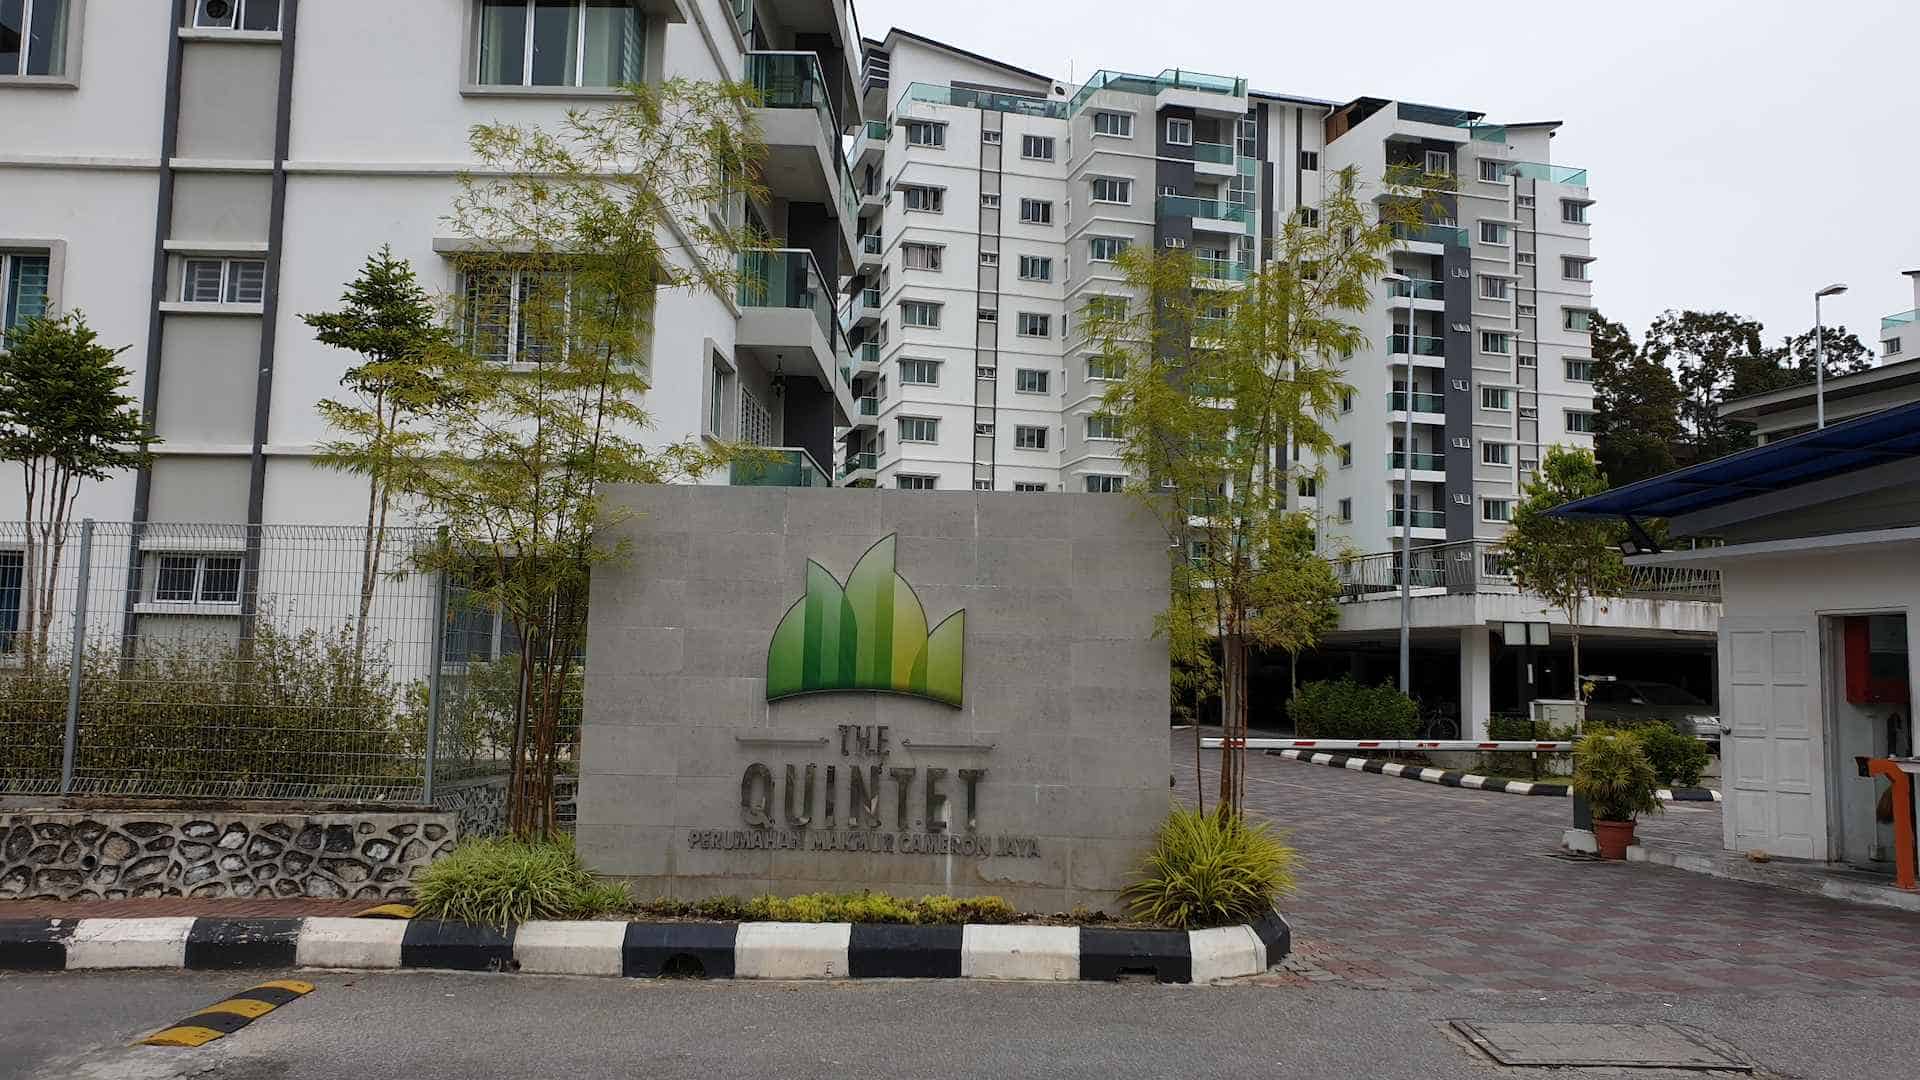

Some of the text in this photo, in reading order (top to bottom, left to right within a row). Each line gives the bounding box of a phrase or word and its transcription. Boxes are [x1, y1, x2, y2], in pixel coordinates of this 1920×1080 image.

[838, 724, 890, 757] THE
[741, 762, 988, 832] QUINTET
[688, 830, 1041, 858] PERUMAHAN MAKMUR CAMERON JAYA
